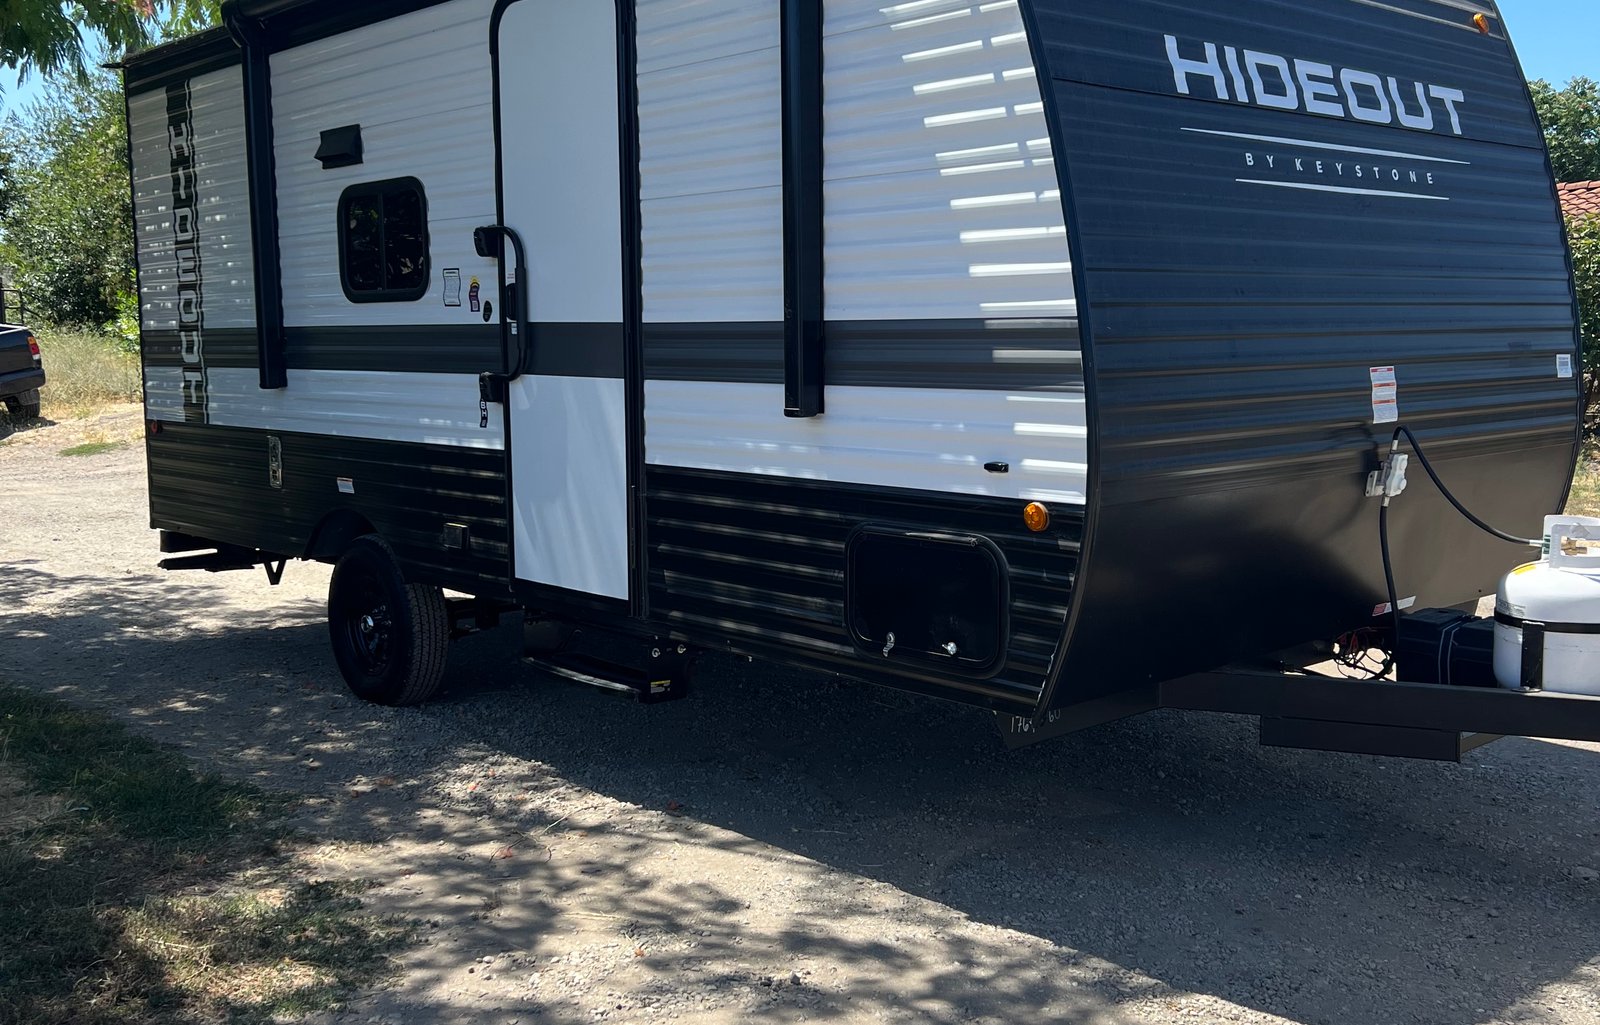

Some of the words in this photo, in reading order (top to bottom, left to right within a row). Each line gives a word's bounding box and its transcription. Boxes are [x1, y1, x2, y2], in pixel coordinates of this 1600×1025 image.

[1163, 34, 1465, 136] HIDEOUT
[1245, 152, 1274, 169] BY
[1294, 158, 1434, 185] KEYSTONE
[169, 122, 201, 404] HIDEOUT
